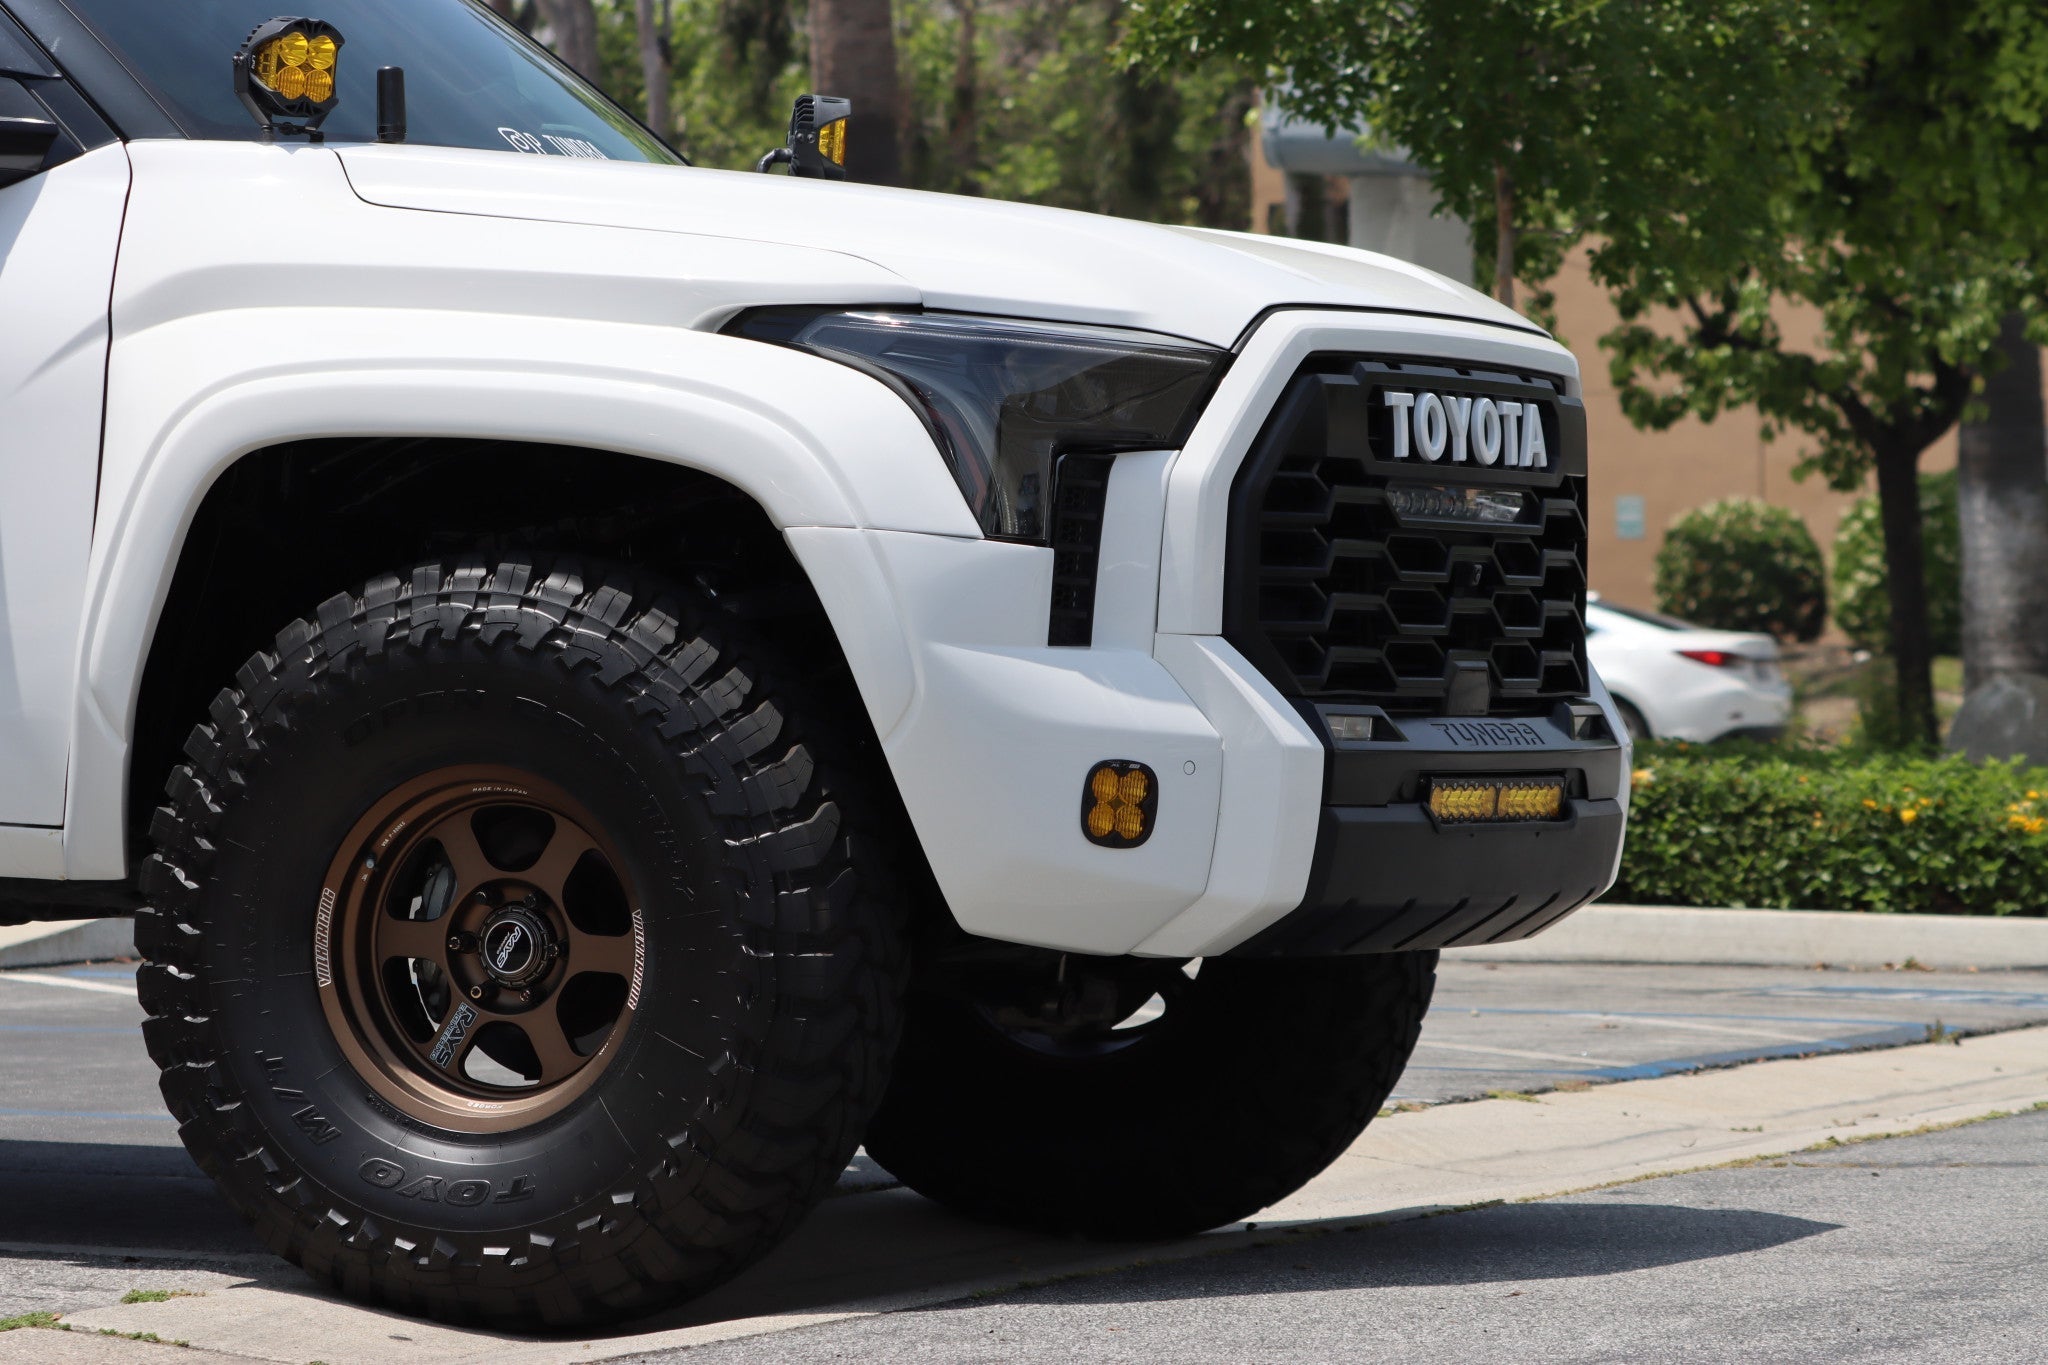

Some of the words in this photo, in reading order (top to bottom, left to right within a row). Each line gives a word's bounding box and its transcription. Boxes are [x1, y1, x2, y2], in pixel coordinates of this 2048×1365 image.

[1384, 391, 1548, 467] TOYOTA
[1430, 722, 1546, 746] TUNDRA
[503, 787, 528, 795] JAPAN
[496, 926, 522, 969] RAYS
[430, 1002, 467, 1061] ENGINEERING
[437, 1007, 478, 1069] RAYS
[358, 1157, 537, 1206] TOYO
